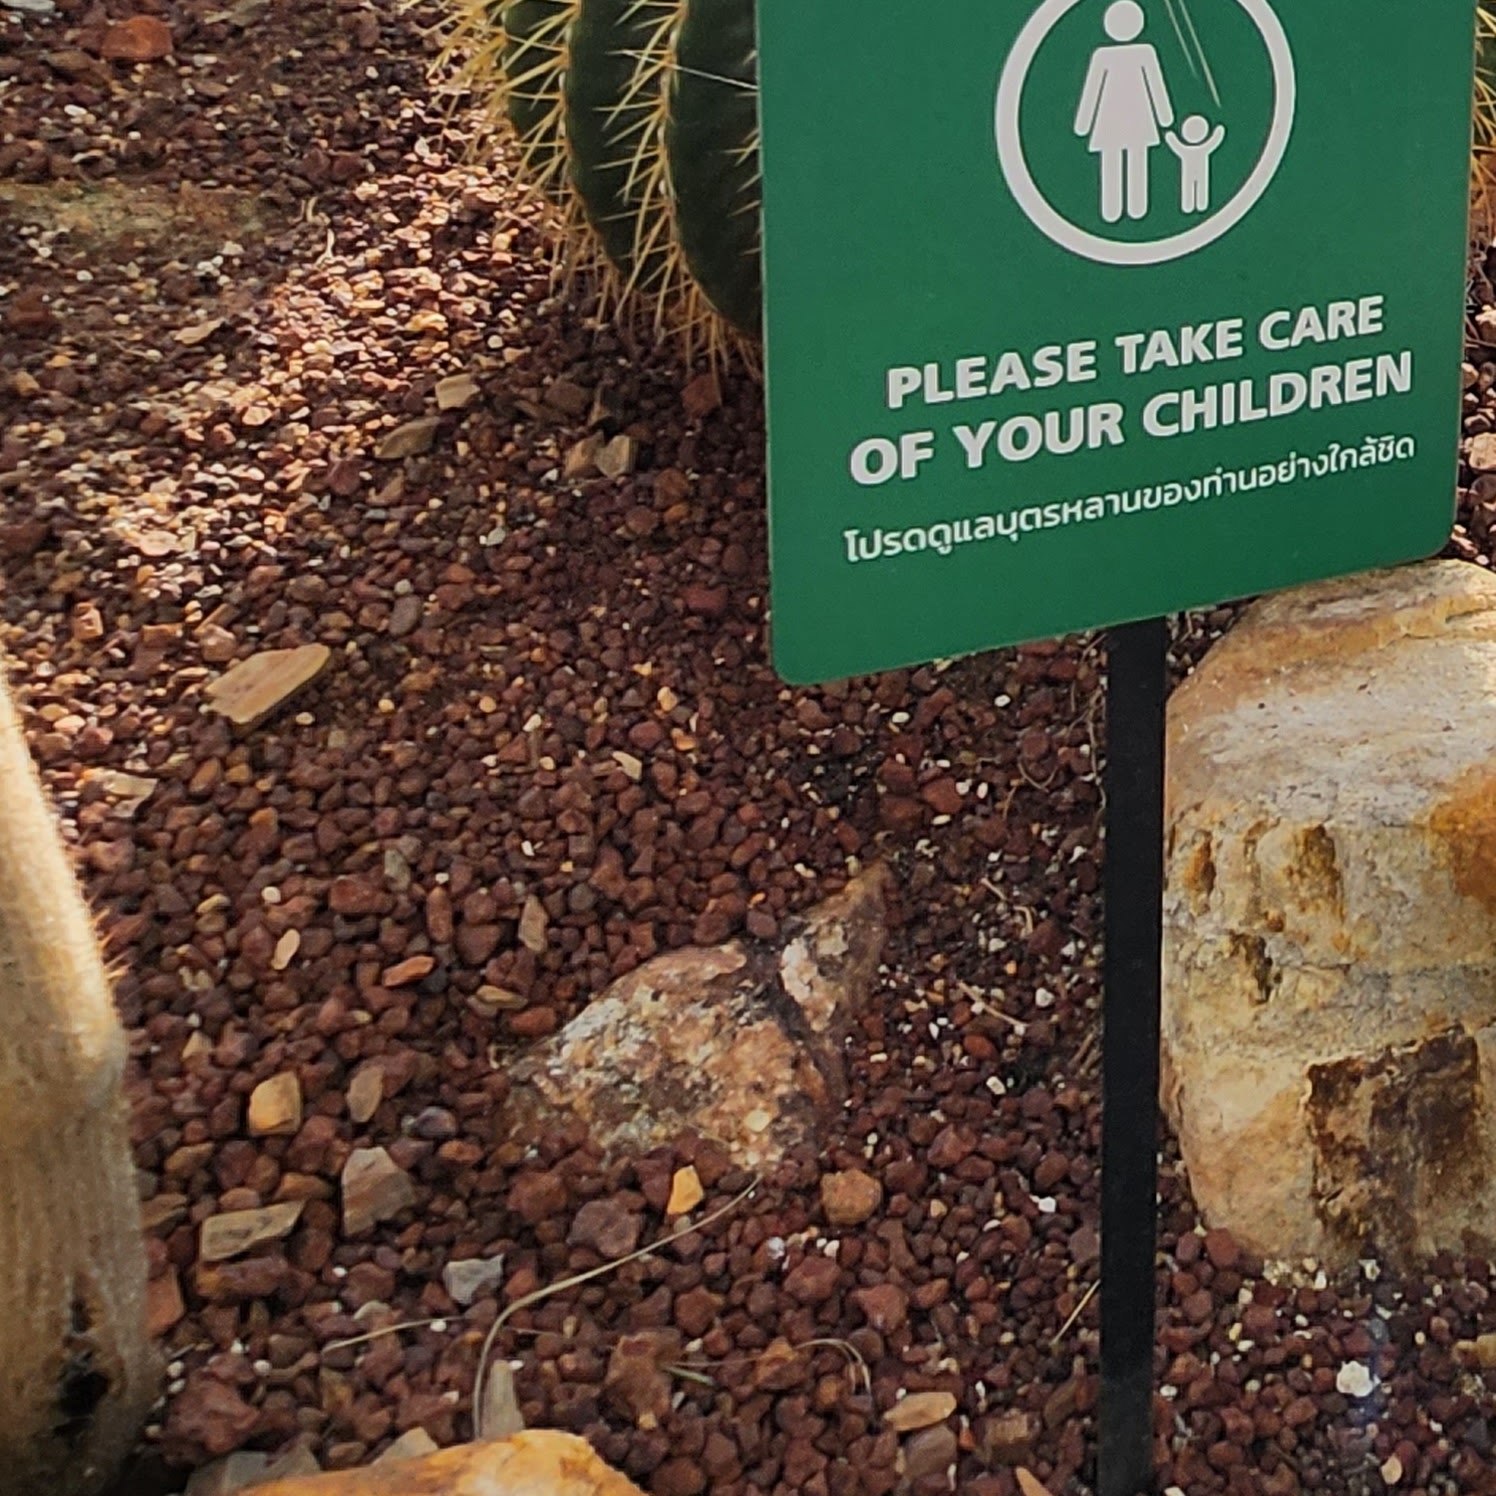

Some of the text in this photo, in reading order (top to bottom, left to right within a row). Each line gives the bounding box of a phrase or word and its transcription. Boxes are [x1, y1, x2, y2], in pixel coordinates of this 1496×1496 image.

[887, 294, 1384, 410] PLEASE TAKE CARE
[849, 350, 1413, 486] OF YOUR CHILDREN
[843, 433, 1416, 564] โปรดดูแลบุตรหลานของท่านอย่างใกล้ชิด
